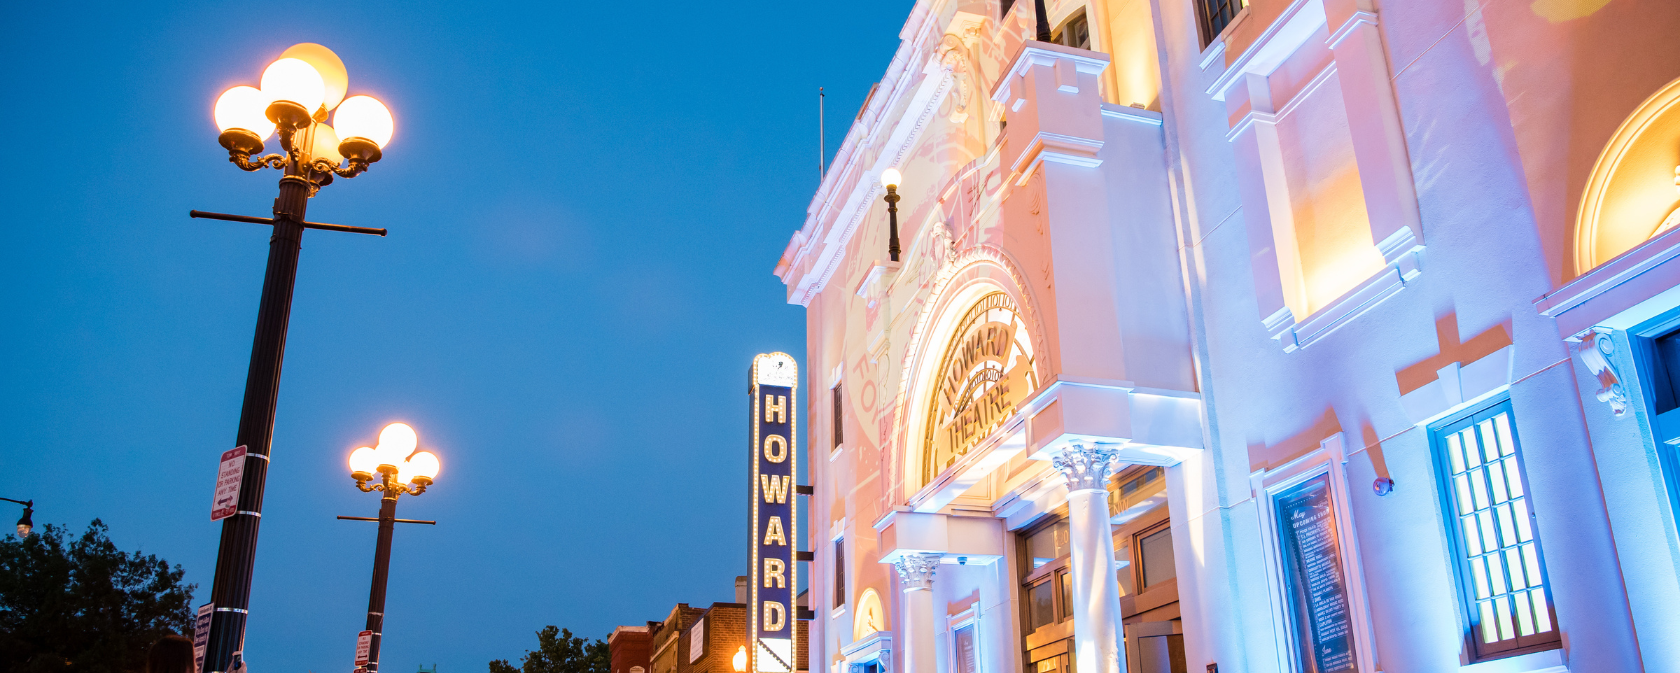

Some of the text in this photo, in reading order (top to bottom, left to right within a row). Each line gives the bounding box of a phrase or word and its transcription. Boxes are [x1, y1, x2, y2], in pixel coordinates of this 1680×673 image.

[943, 326, 1009, 406] HOWARD
[947, 376, 1012, 453] THEATRE
[229, 460, 235, 468] NO
[221, 467, 240, 479] STANDING
[225, 476, 240, 486] PARKING
[218, 488, 226, 496] ANY
[760, 394, 790, 632] HOWARD
[1113, 498, 1129, 518] NW
